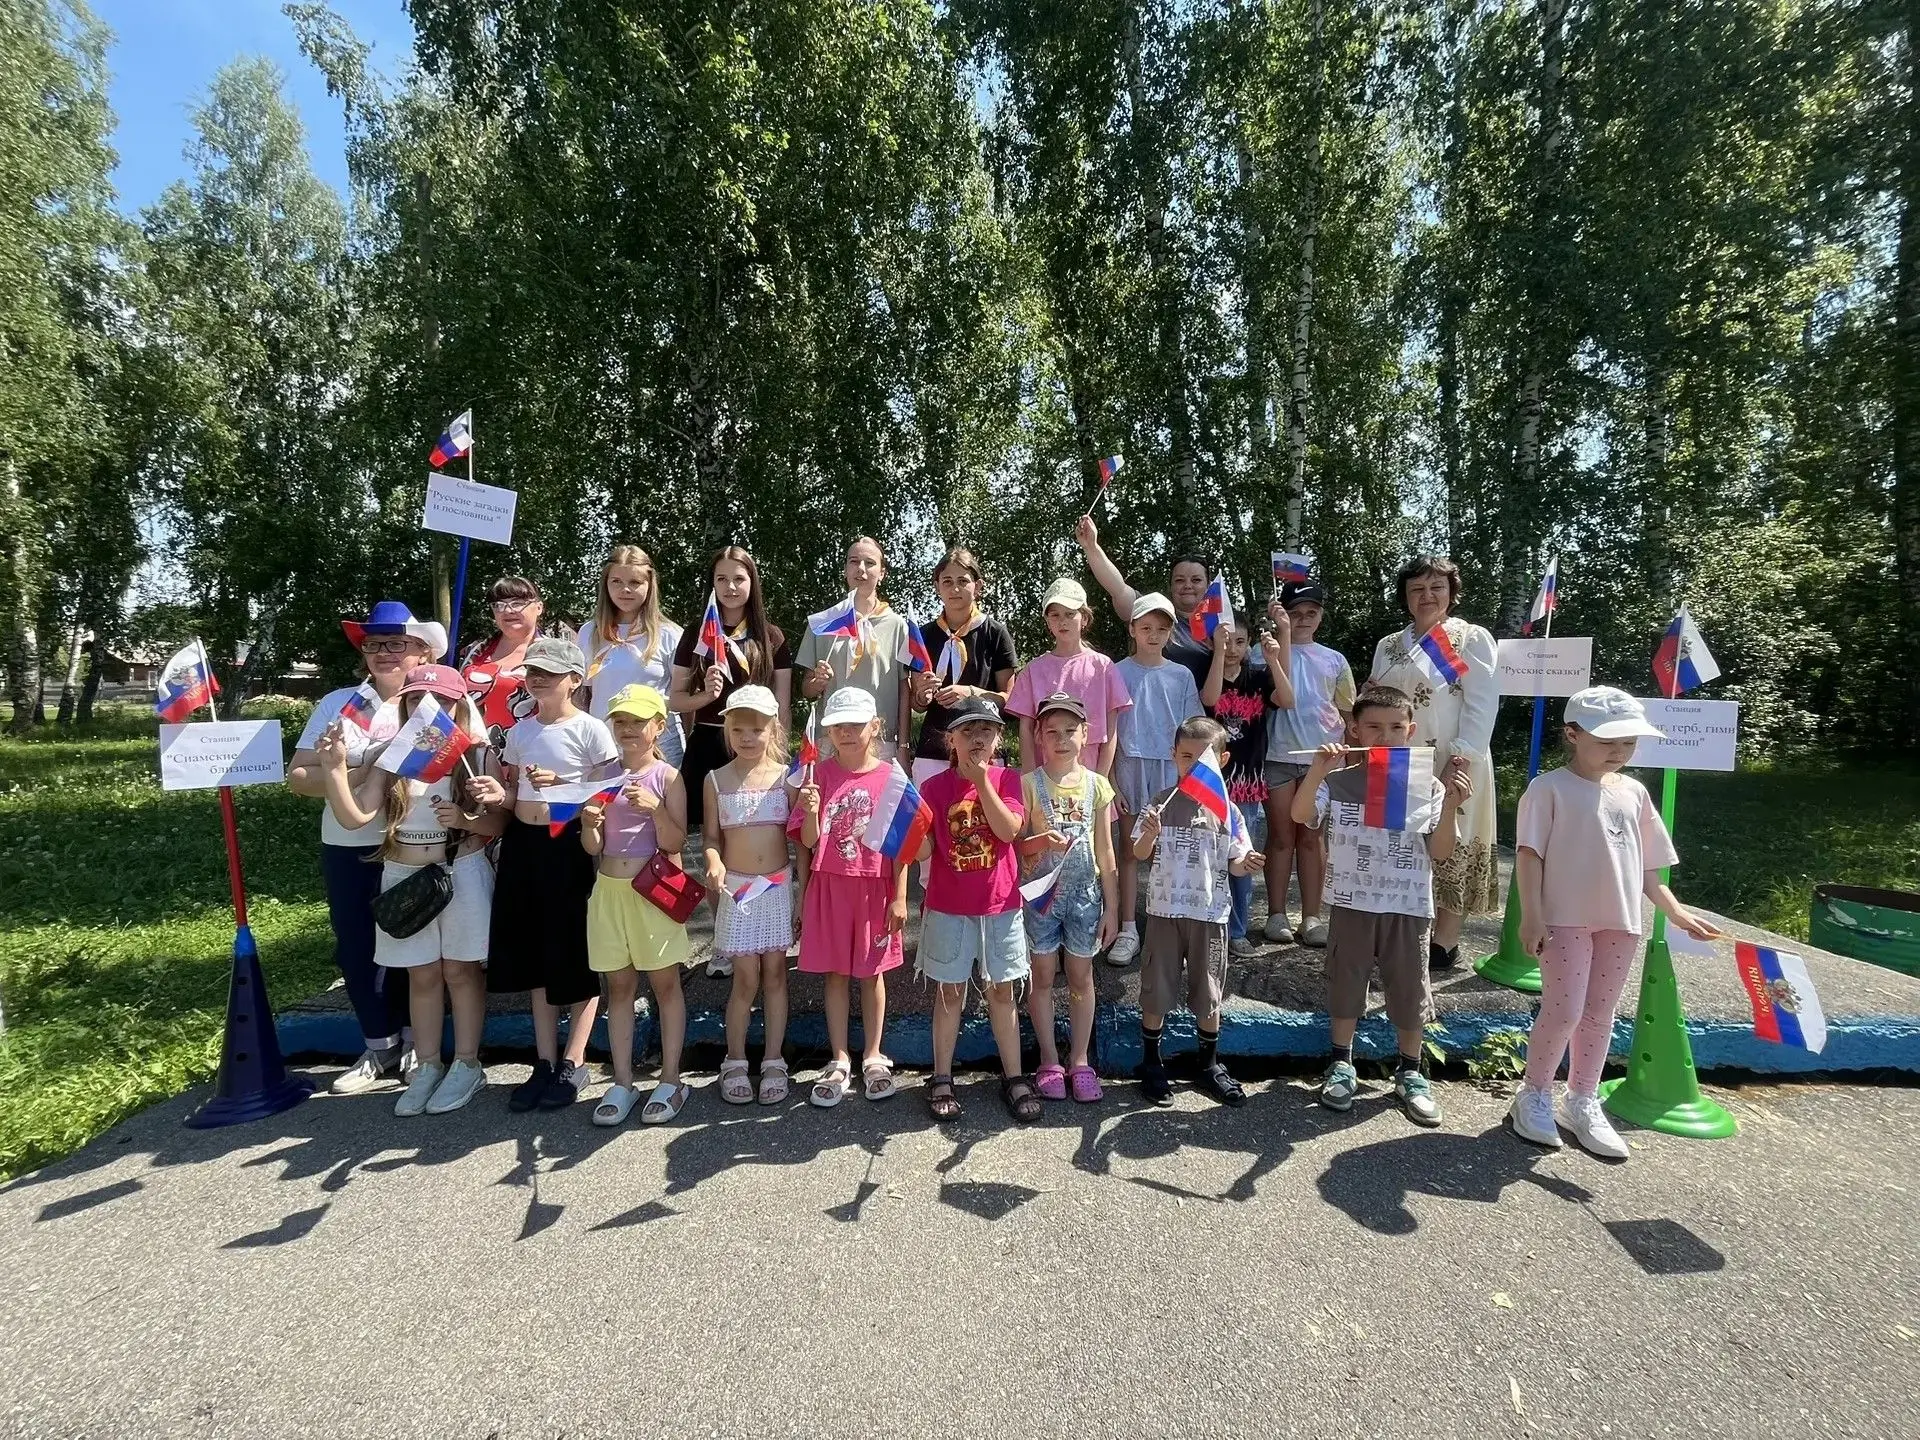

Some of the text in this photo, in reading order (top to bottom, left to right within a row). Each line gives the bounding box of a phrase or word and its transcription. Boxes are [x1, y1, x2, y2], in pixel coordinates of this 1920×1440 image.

[441, 505, 494, 522] пословицы
[474, 501, 509, 515] загадки
[1501, 665, 1586, 676] "Русские сказки"
[1665, 704, 1701, 713] Станция
[1672, 723, 1701, 734] герб,
[1705, 726, 1735, 734] гимн
[200, 736, 241, 744] Станция
[167, 752, 238, 763] "Сиамские
[209, 761, 277, 775] близнецы"
